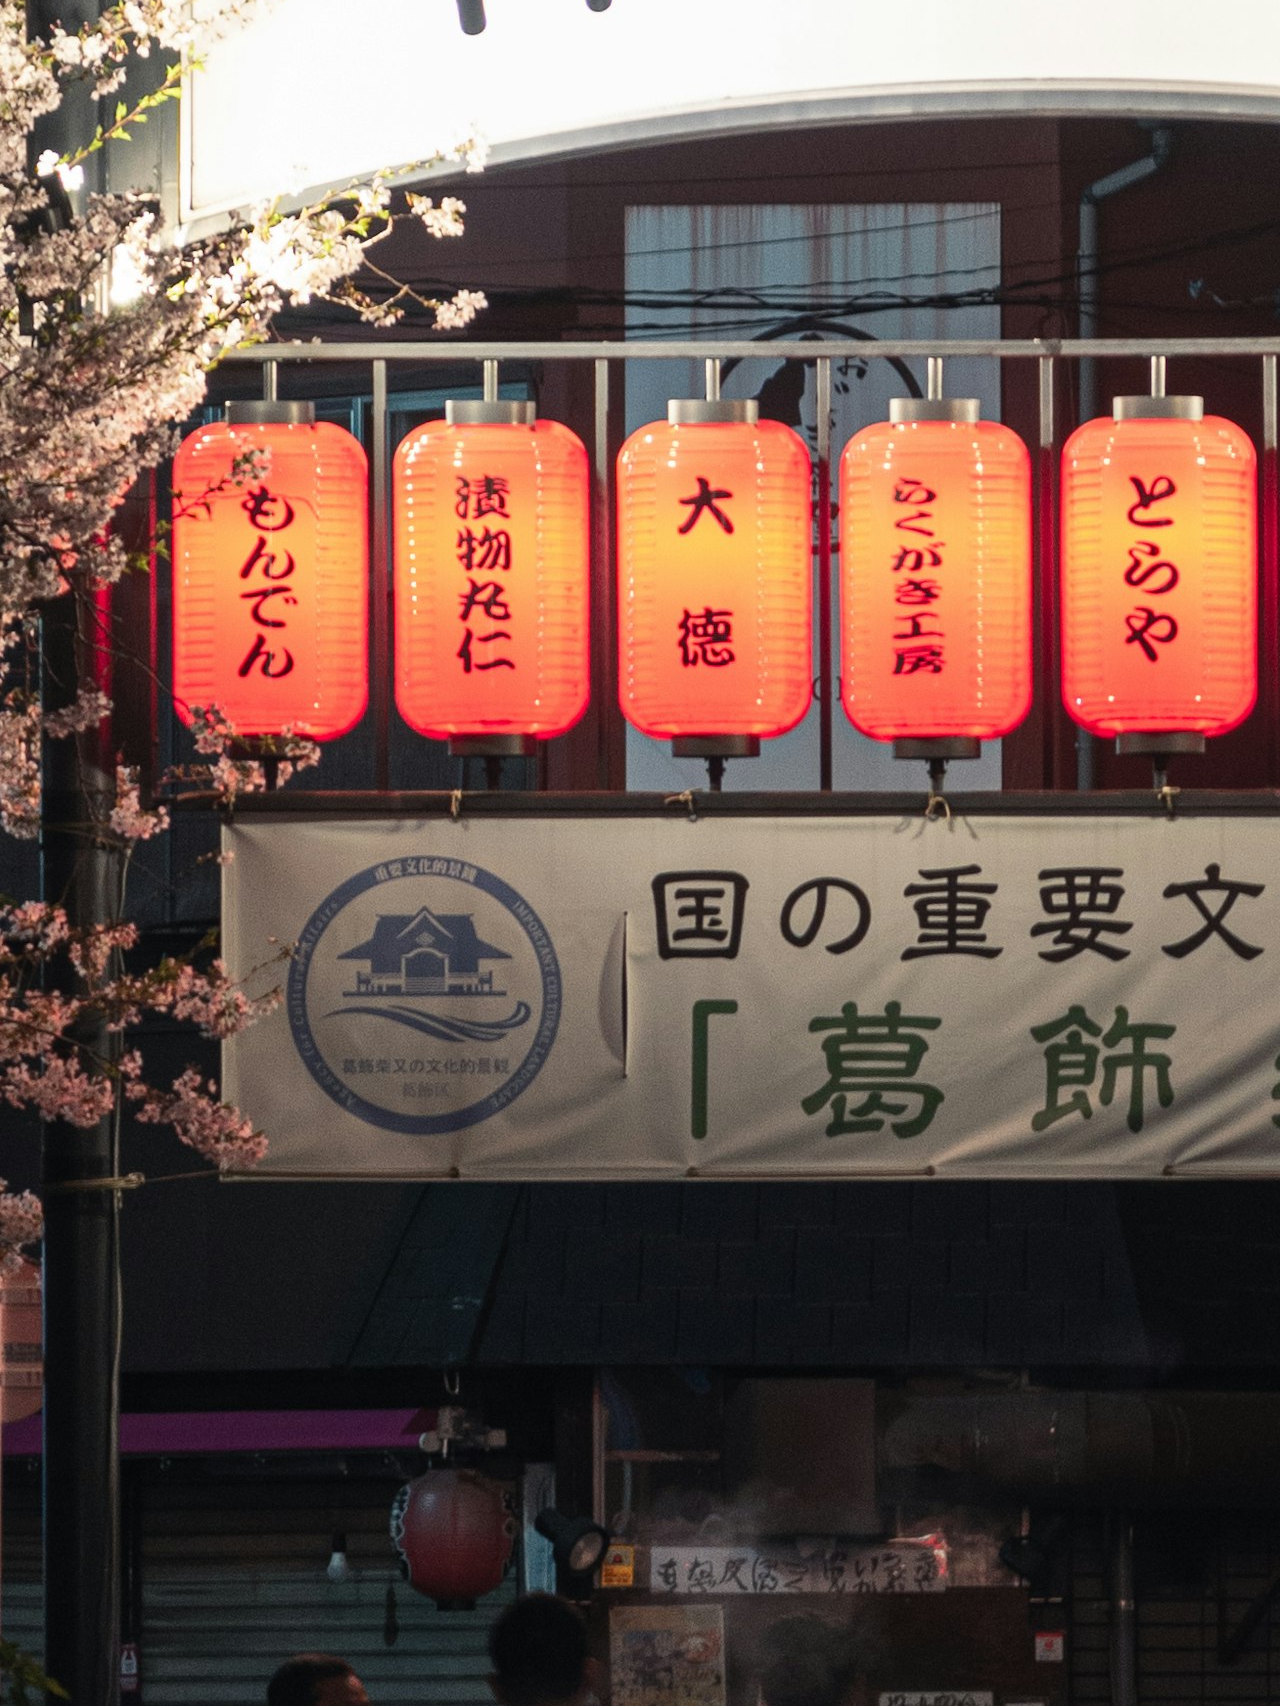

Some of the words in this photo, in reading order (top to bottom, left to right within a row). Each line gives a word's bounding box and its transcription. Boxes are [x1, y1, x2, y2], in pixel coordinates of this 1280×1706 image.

[238, 485, 298, 678] もんでん
[678, 478, 736, 668] 大徳
[892, 477, 946, 676] らくがき工房
[1124, 476, 1180, 663] とらや
[373, 857, 479, 884] 重要文化的景観
[342, 1057, 510, 1076] 葛飾柴又の文化的景観
